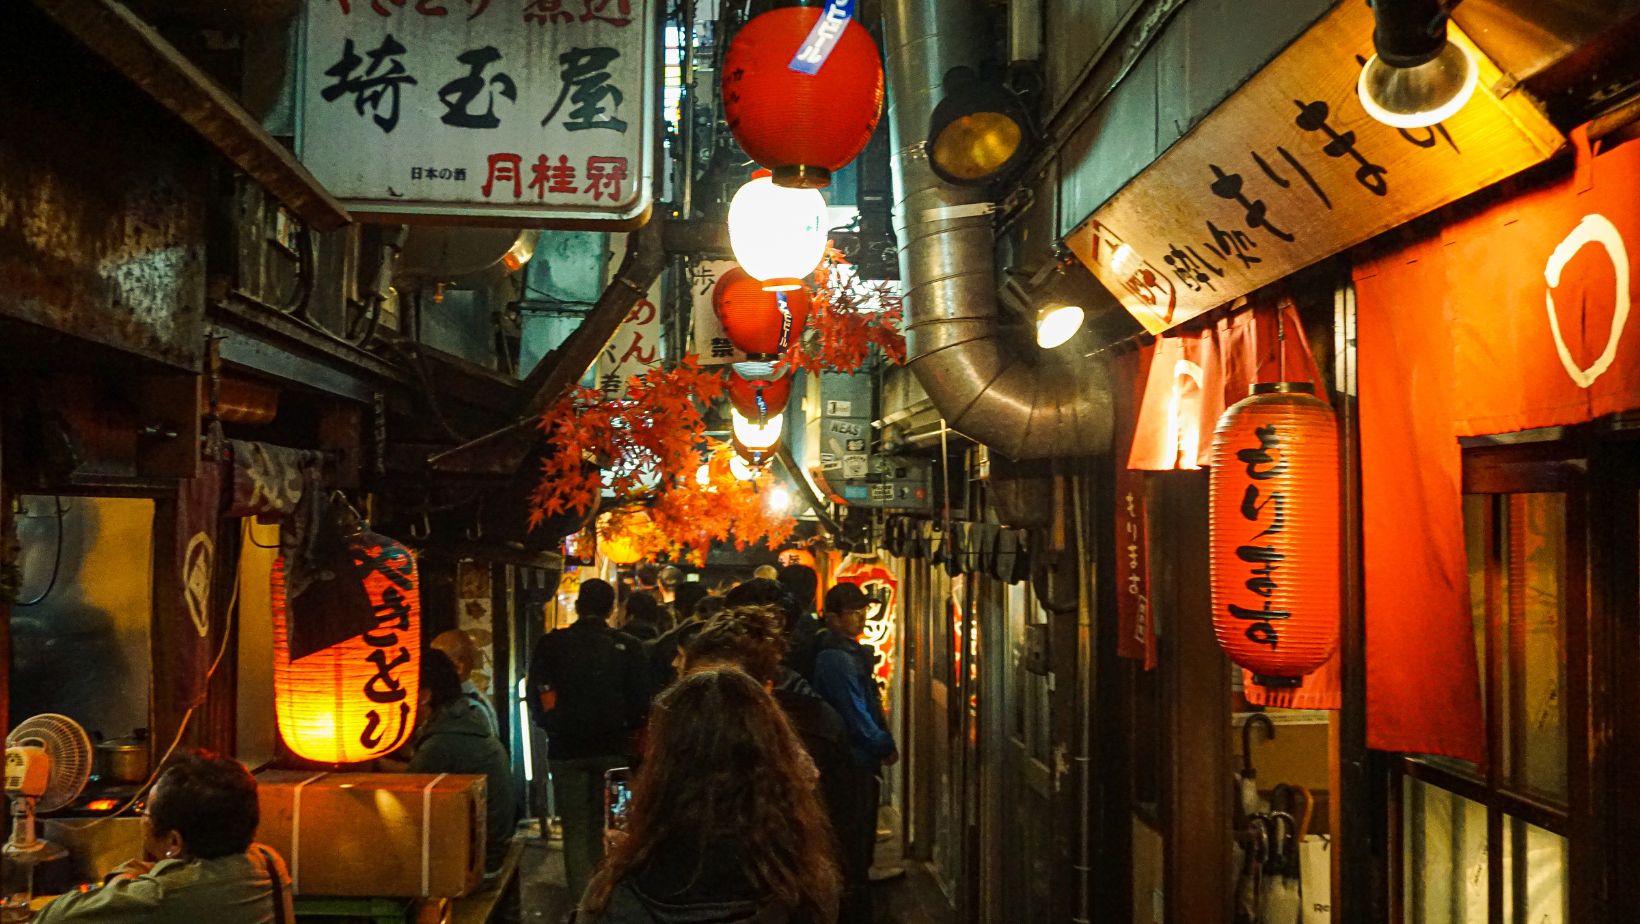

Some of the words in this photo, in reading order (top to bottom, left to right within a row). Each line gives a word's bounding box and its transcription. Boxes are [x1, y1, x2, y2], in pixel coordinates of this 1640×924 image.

[321, 34, 629, 134] 埼玉屋
[411, 167, 467, 181] 日本の酒
[481, 153, 628, 201] 月桂冠
[353, 546, 415, 757] やきとり
